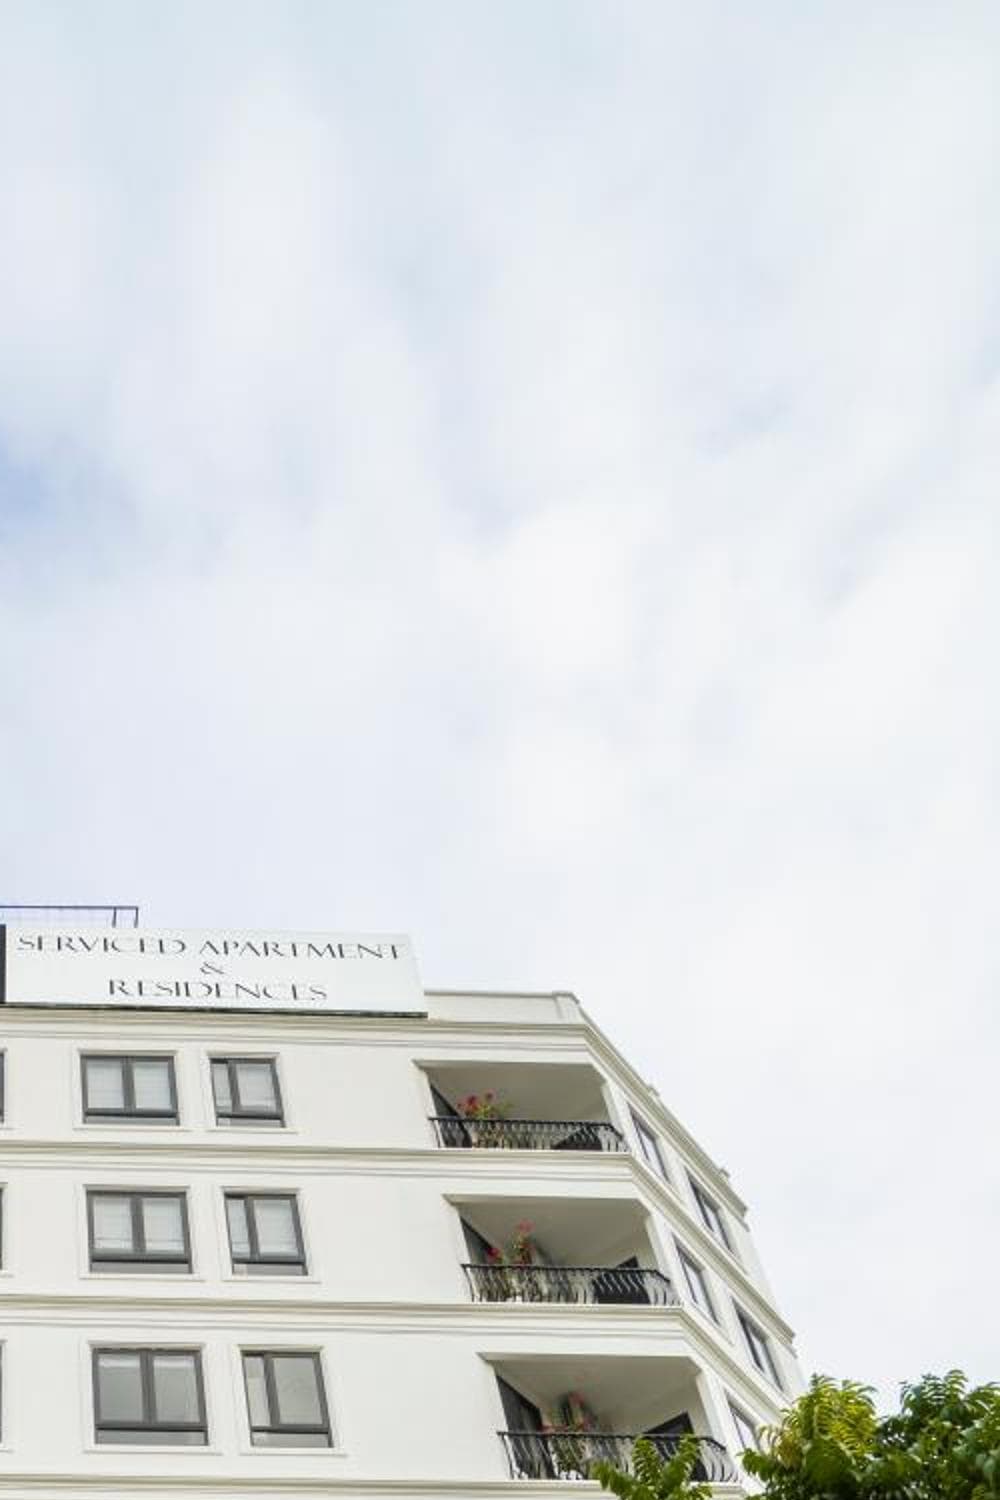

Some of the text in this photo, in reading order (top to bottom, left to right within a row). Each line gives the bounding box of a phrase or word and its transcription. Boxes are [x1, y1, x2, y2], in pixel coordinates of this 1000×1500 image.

[17, 935, 405, 960] SERVICED APARTMENT
[199, 961, 226, 976] &
[108, 979, 328, 1001] RESIDENCES
